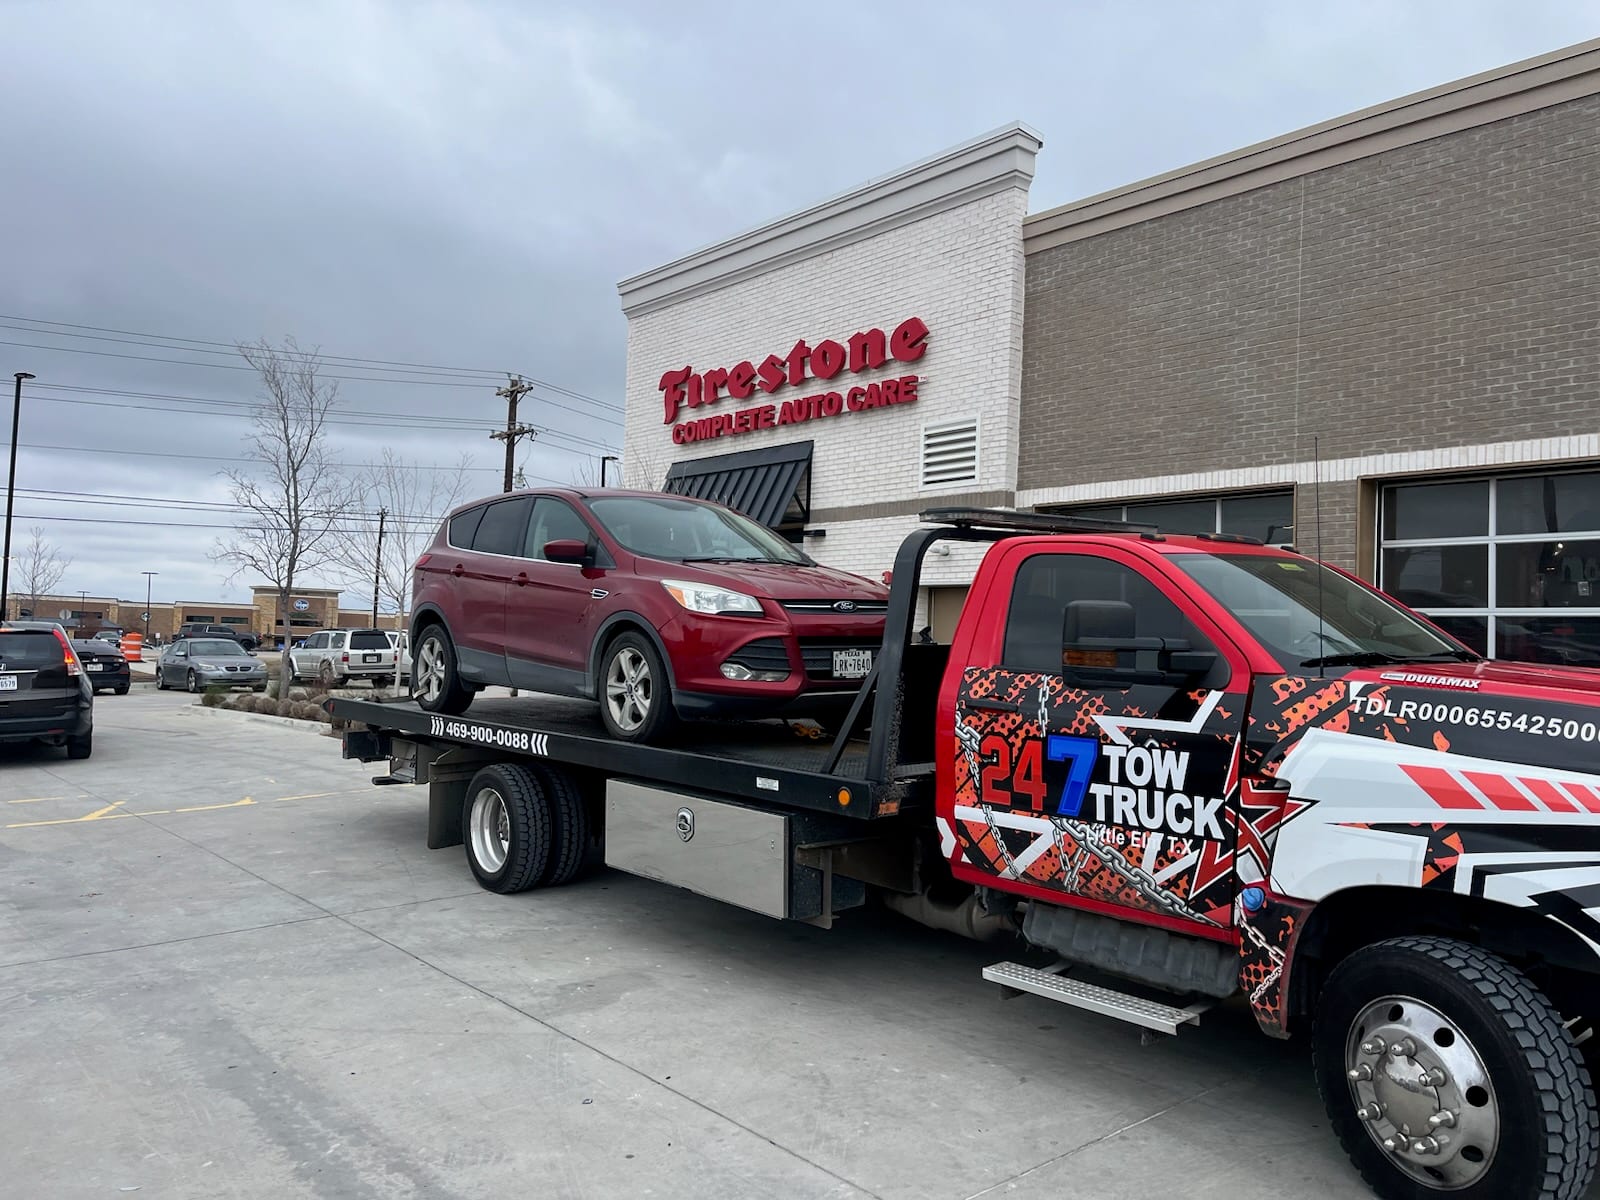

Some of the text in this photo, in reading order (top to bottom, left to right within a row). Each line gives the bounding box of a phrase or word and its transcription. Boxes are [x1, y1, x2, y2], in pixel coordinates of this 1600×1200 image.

[659, 316, 930, 424] Firestone
[672, 404, 776, 444] COMPLETE
[778, 391, 843, 425] AUTO
[847, 375, 918, 411] CARE
[1406, 673, 1480, 689] DURAMAX
[446, 722, 529, 750] 469-900-0088
[1351, 696, 1600, 744] TDLR00065542500
[1102, 745, 1190, 791] TOW
[1089, 782, 1226, 840] TRUCK
[1131, 830, 1160, 851] El
